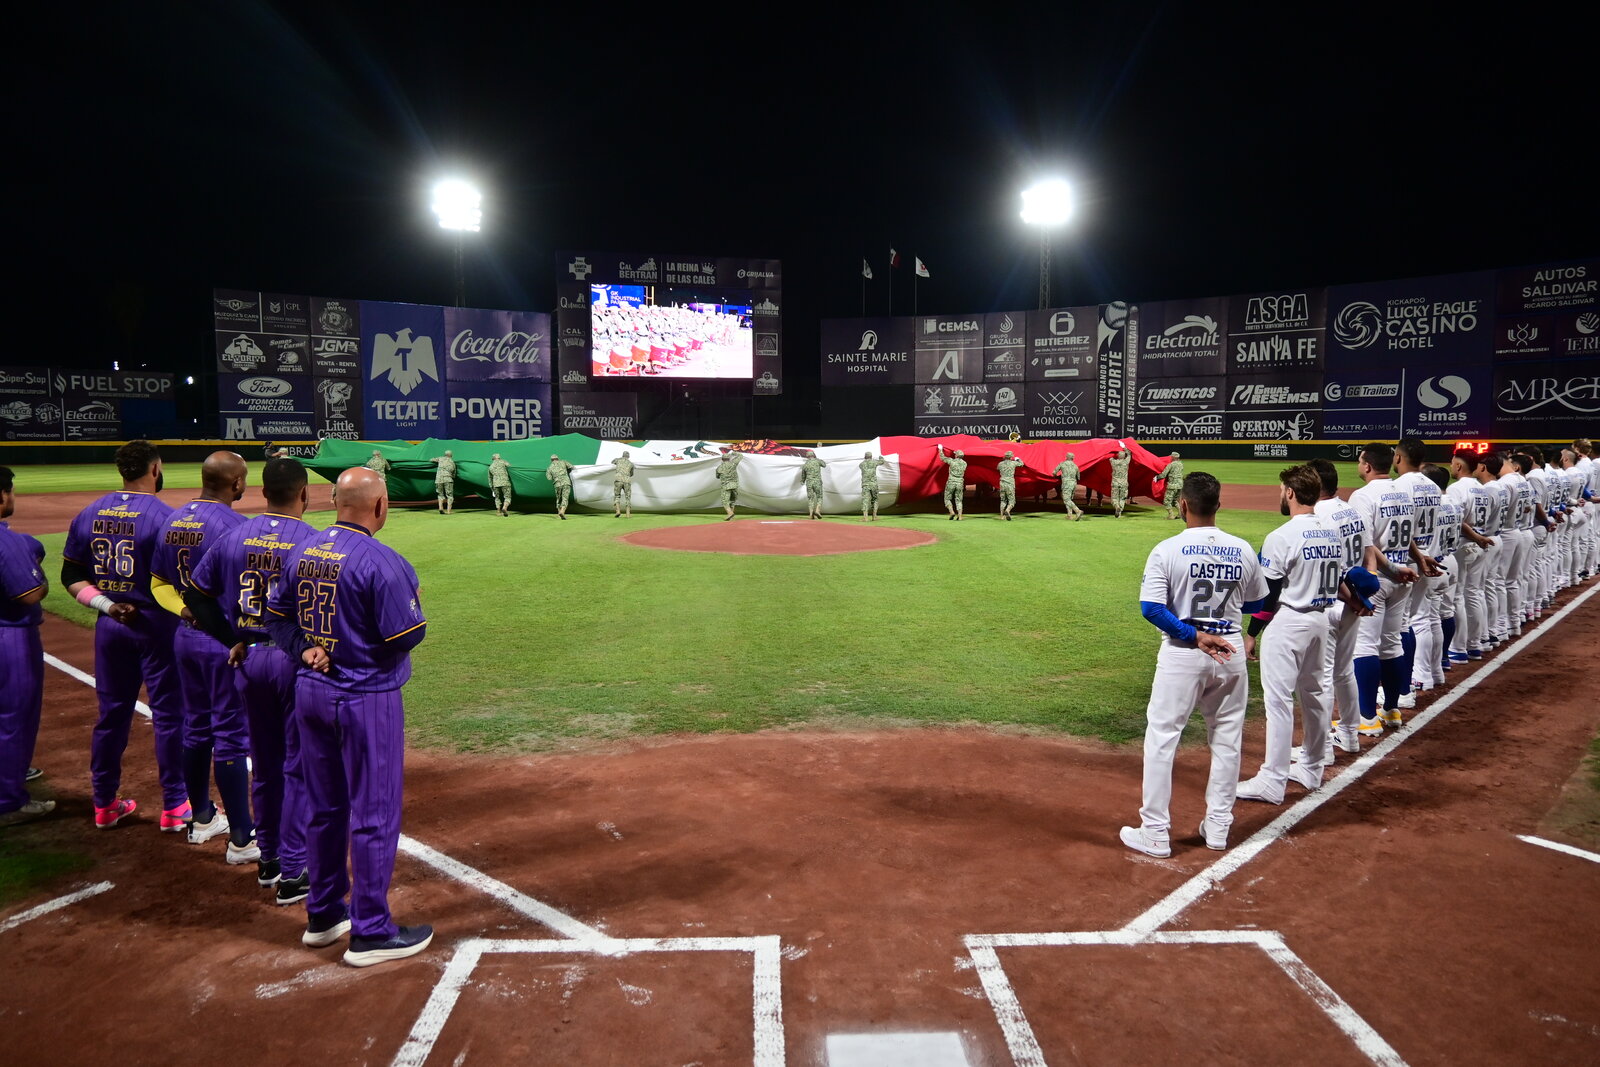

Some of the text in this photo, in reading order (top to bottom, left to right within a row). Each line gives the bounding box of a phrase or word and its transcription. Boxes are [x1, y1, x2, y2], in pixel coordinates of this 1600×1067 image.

[666, 262, 698, 273] LA REINA
[1534, 266, 1586, 282] AUTOS
[619, 270, 658, 280] BERTRAN
[666, 274, 716, 284] DE LAS CALES
[1522, 280, 1598, 298] SALDIVAR
[286, 302, 301, 310] GPL
[1387, 297, 1426, 306] KICKAPOO
[1558, 298, 1594, 306] SALDIVAR
[1246, 294, 1308, 324] ASGA
[1387, 300, 1478, 319] LUCKY EAGLE
[938, 320, 979, 332] CEMSA
[1386, 314, 1477, 336] CASINO
[314, 340, 347, 352] JGM
[450, 329, 544, 364] Coca-Cola
[1034, 336, 1090, 347] GUTIERREZ
[1128, 320, 1136, 364] RESULTADO
[1146, 333, 1219, 350] Electrolit
[1388, 336, 1434, 350] HOTEL
[1297, 338, 1316, 360] FE
[828, 352, 907, 364] SAINTE MARIE
[848, 364, 888, 372] HOSPITAL
[1128, 368, 1136, 377] ES
[71, 375, 171, 393] FUEL STOP
[250, 380, 282, 394] Ford
[1099, 353, 1108, 413] IMPULSANDO EL
[1108, 351, 1122, 418] DEPORTE
[1253, 384, 1290, 394] GRUAS
[951, 386, 988, 394] HARINA
[1147, 386, 1216, 400] TURISTICOS
[1348, 386, 1396, 396] GG Trailers
[950, 395, 989, 407] Miller
[1127, 381, 1136, 420] ESFUERZO
[1251, 392, 1318, 404] RESEMSA
[66, 410, 117, 420] Electrolit
[371, 400, 440, 420] TECATE
[450, 398, 542, 419] POWER
[1044, 406, 1078, 416] PASEO
[564, 416, 634, 428] GREENBRIER
[1032, 416, 1087, 425] MONCLOVA
[1418, 410, 1467, 422] simas
[225, 418, 256, 440] M
[258, 426, 312, 434] MONCLOVA
[325, 420, 354, 432] Little
[492, 420, 542, 440] ADE
[918, 424, 1020, 434] ZÓCALO MONCLOVA
[1127, 424, 1134, 432] EL
[1138, 424, 1222, 435] PUERTO VERDE
[1232, 420, 1286, 432] OFERTON
[317, 430, 358, 440] Caesars
[600, 428, 634, 438] GIMSA
[98, 508, 142, 518] alsuper
[92, 520, 135, 536] MEJIA
[170, 520, 204, 530] alsuper
[1418, 508, 1434, 535] 41
[165, 531, 204, 546] SCHOOP
[1388, 520, 1411, 548] 38
[243, 538, 296, 551] alsuper
[1182, 545, 1242, 556] GREENBRIER
[1345, 534, 1362, 567] 18
[90, 538, 135, 578] 96
[304, 546, 346, 561] alsuper
[1302, 546, 1341, 560] GONZALE
[247, 550, 283, 572] PIÑA
[297, 560, 342, 581] ROJAS
[1190, 563, 1242, 580] CASTRO
[1318, 561, 1338, 595] 10
[1190, 579, 1240, 618] 27
[298, 580, 338, 635] 27
